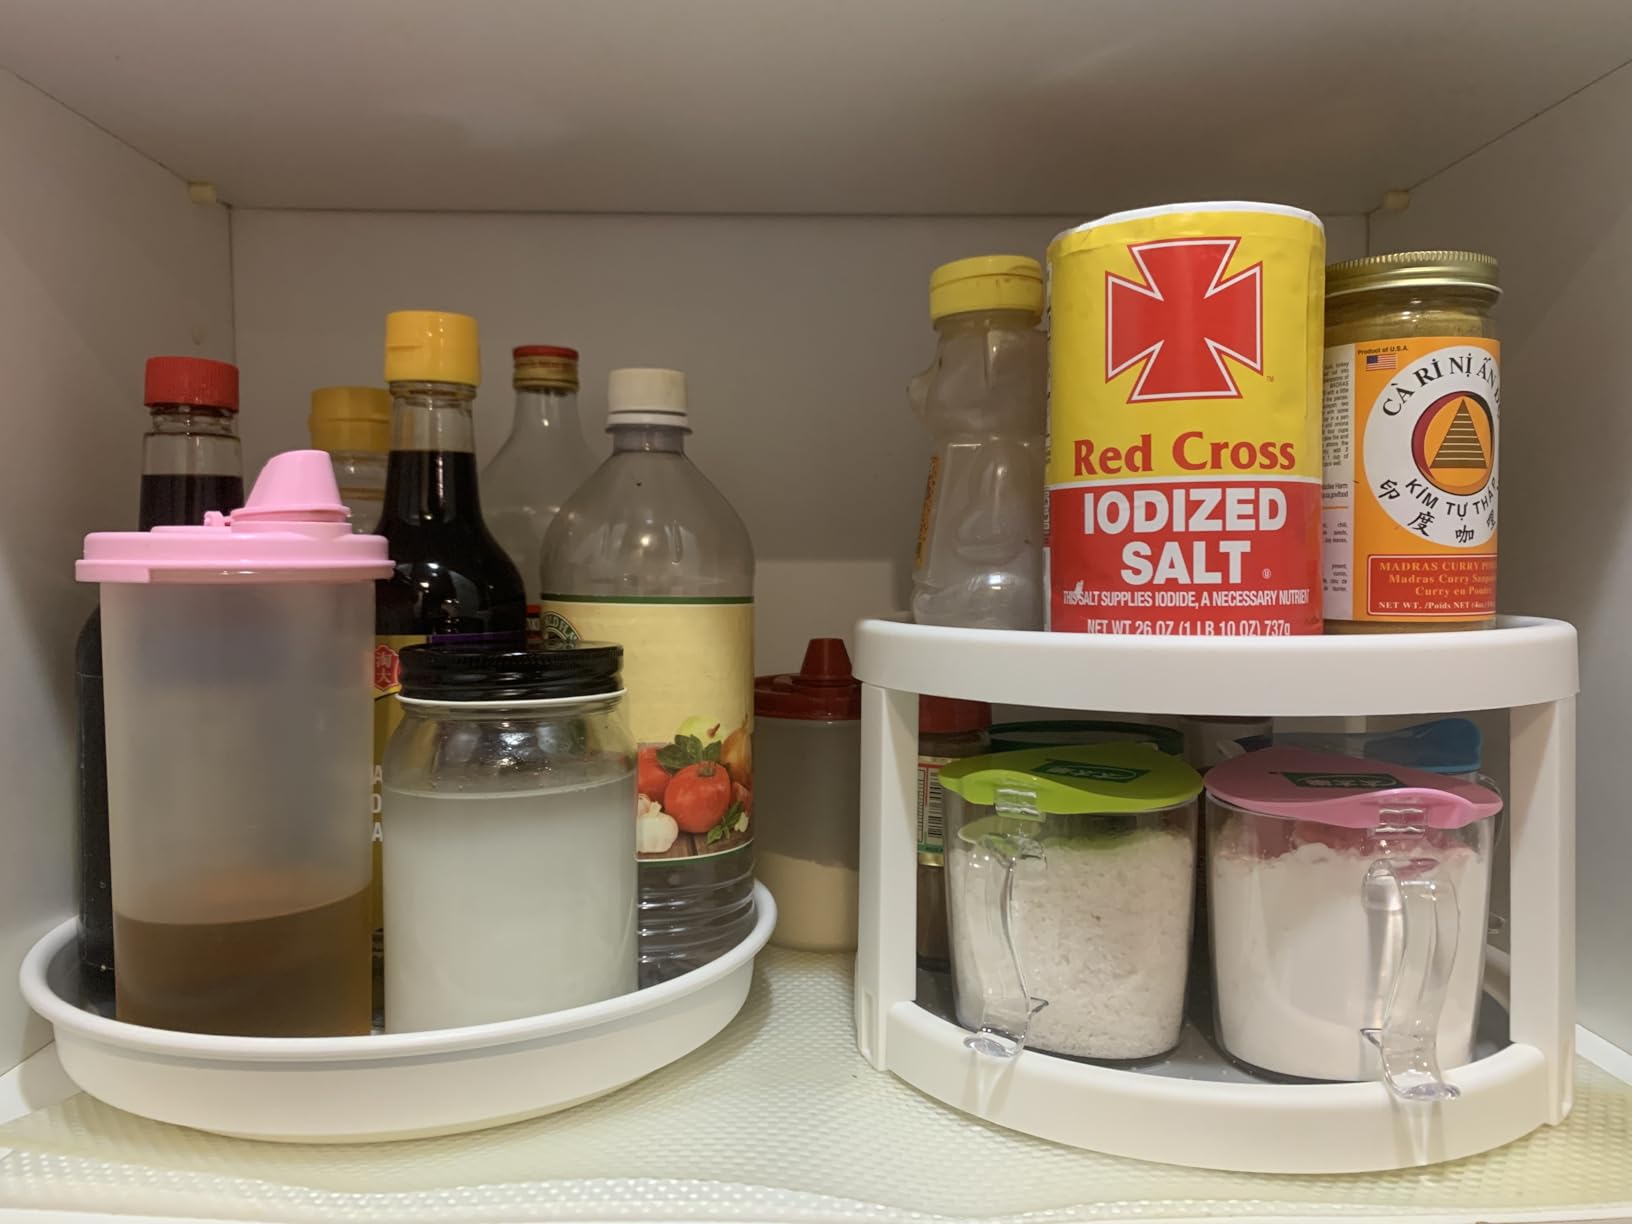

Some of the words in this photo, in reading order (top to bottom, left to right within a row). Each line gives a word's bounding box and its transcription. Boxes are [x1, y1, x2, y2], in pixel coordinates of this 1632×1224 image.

[1357, 347, 1380, 355] Product
[1074, 433, 1152, 476] Red
[1172, 431, 1296, 472] Cross
[1083, 487, 1288, 535] IODIZED
[1120, 540, 1252, 586] SALT
[1379, 561, 1438, 572] MADRAS
[1441, 561, 1479, 572] CURRY
[1389, 574, 1435, 584] Madras
[1438, 574, 1469, 585] Curry
[1077, 590, 1100, 605] SALT
[1101, 590, 1153, 607] SUPPLIES
[1155, 590, 1199, 609] IODIDE,
[1201, 590, 1213, 606] A
[1213, 589, 1278, 607] NECESSARY
[1415, 587, 1450, 598] Curry
[1453, 588, 1466, 596] en
[1379, 601, 1400, 610] NET
[1402, 601, 1423, 610] WT.
[1453, 600, 1470, 610] NET
[1087, 619, 1107, 634] NET
[1112, 619, 1131, 634] WT
[1135, 619, 1152, 635] 26
[1155, 619, 1174, 635] OZ
[1219, 619, 1235, 636] 10
